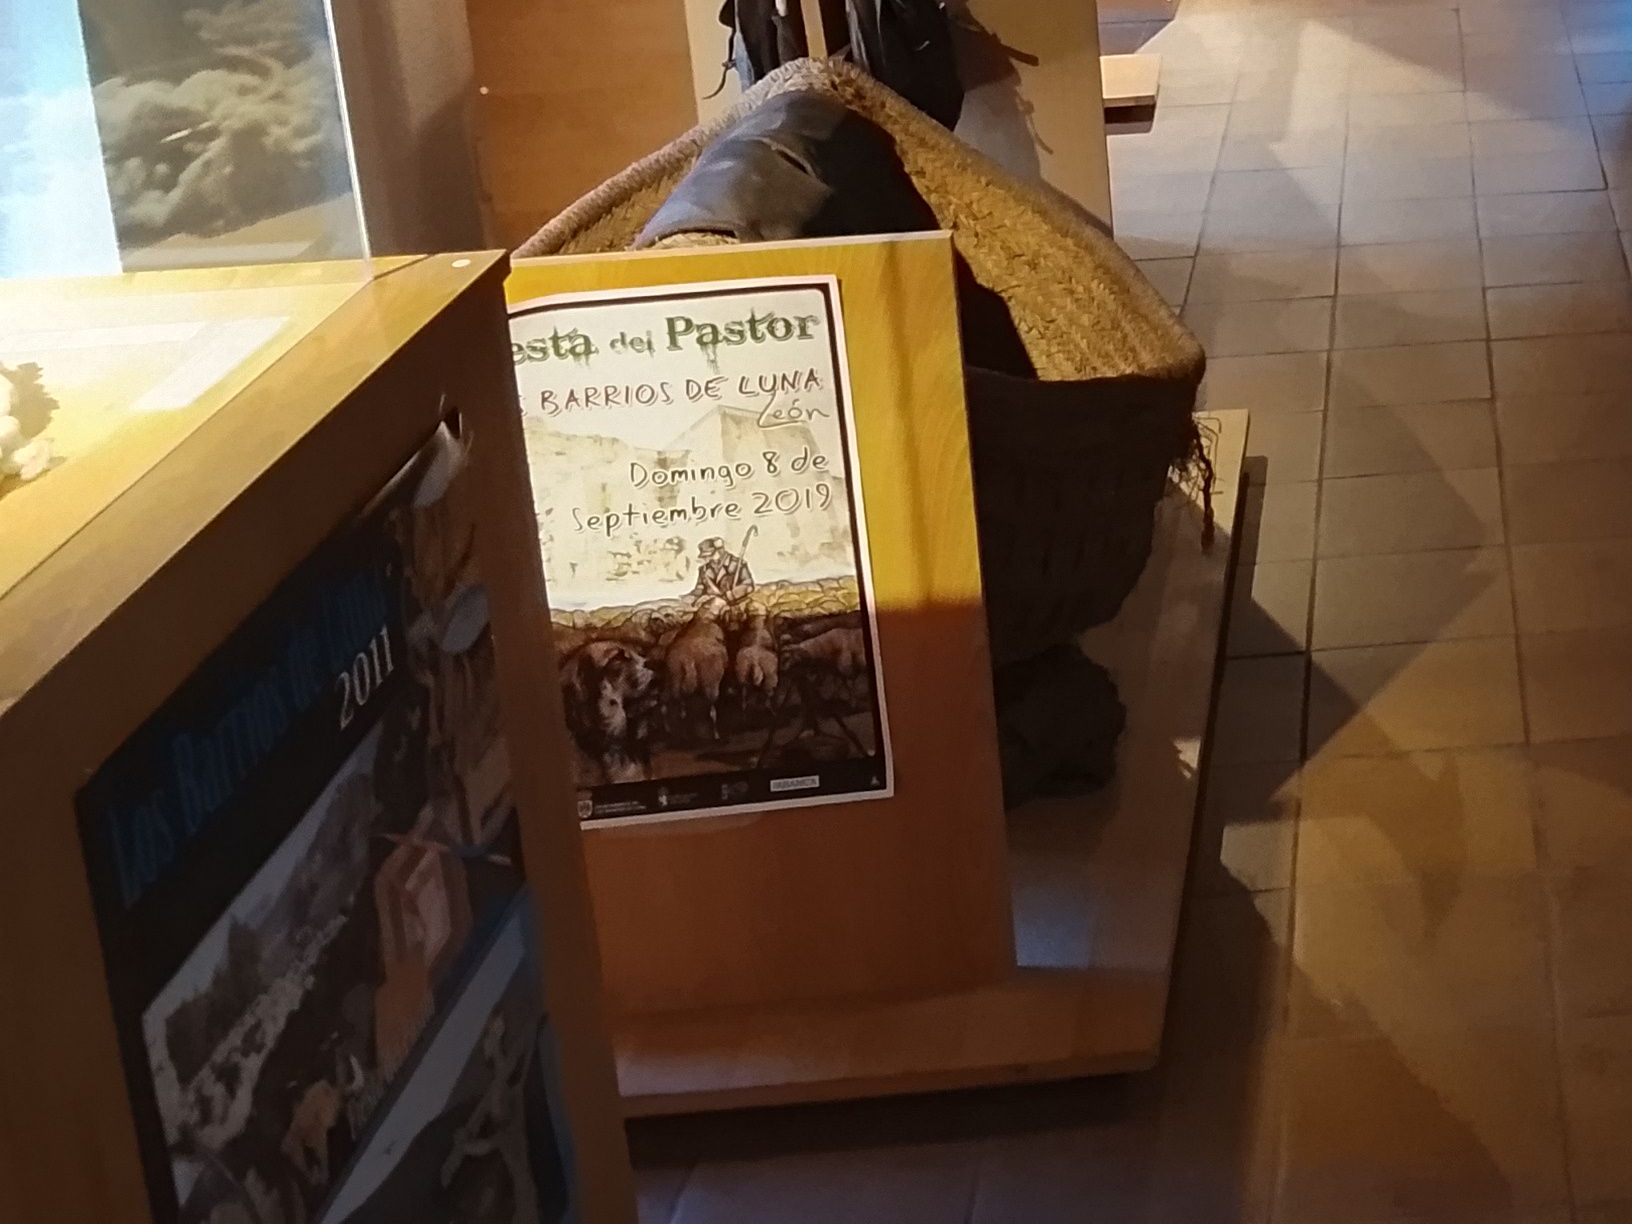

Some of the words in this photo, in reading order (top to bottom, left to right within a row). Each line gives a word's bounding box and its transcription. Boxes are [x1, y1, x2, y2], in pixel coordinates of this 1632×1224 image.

[511, 326, 597, 363] esta
[665, 309, 820, 356] Pastor
[540, 382, 674, 416] BARRIOS
[685, 376, 729, 400] DE
[738, 368, 823, 396] LUNA
[758, 393, 830, 428] León
[630, 462, 754, 489] Domingo
[762, 450, 779, 475] 8
[791, 446, 829, 473] de
[572, 496, 741, 536] Septiembre
[752, 483, 831, 516] 2019
[336, 623, 394, 732] 2011
